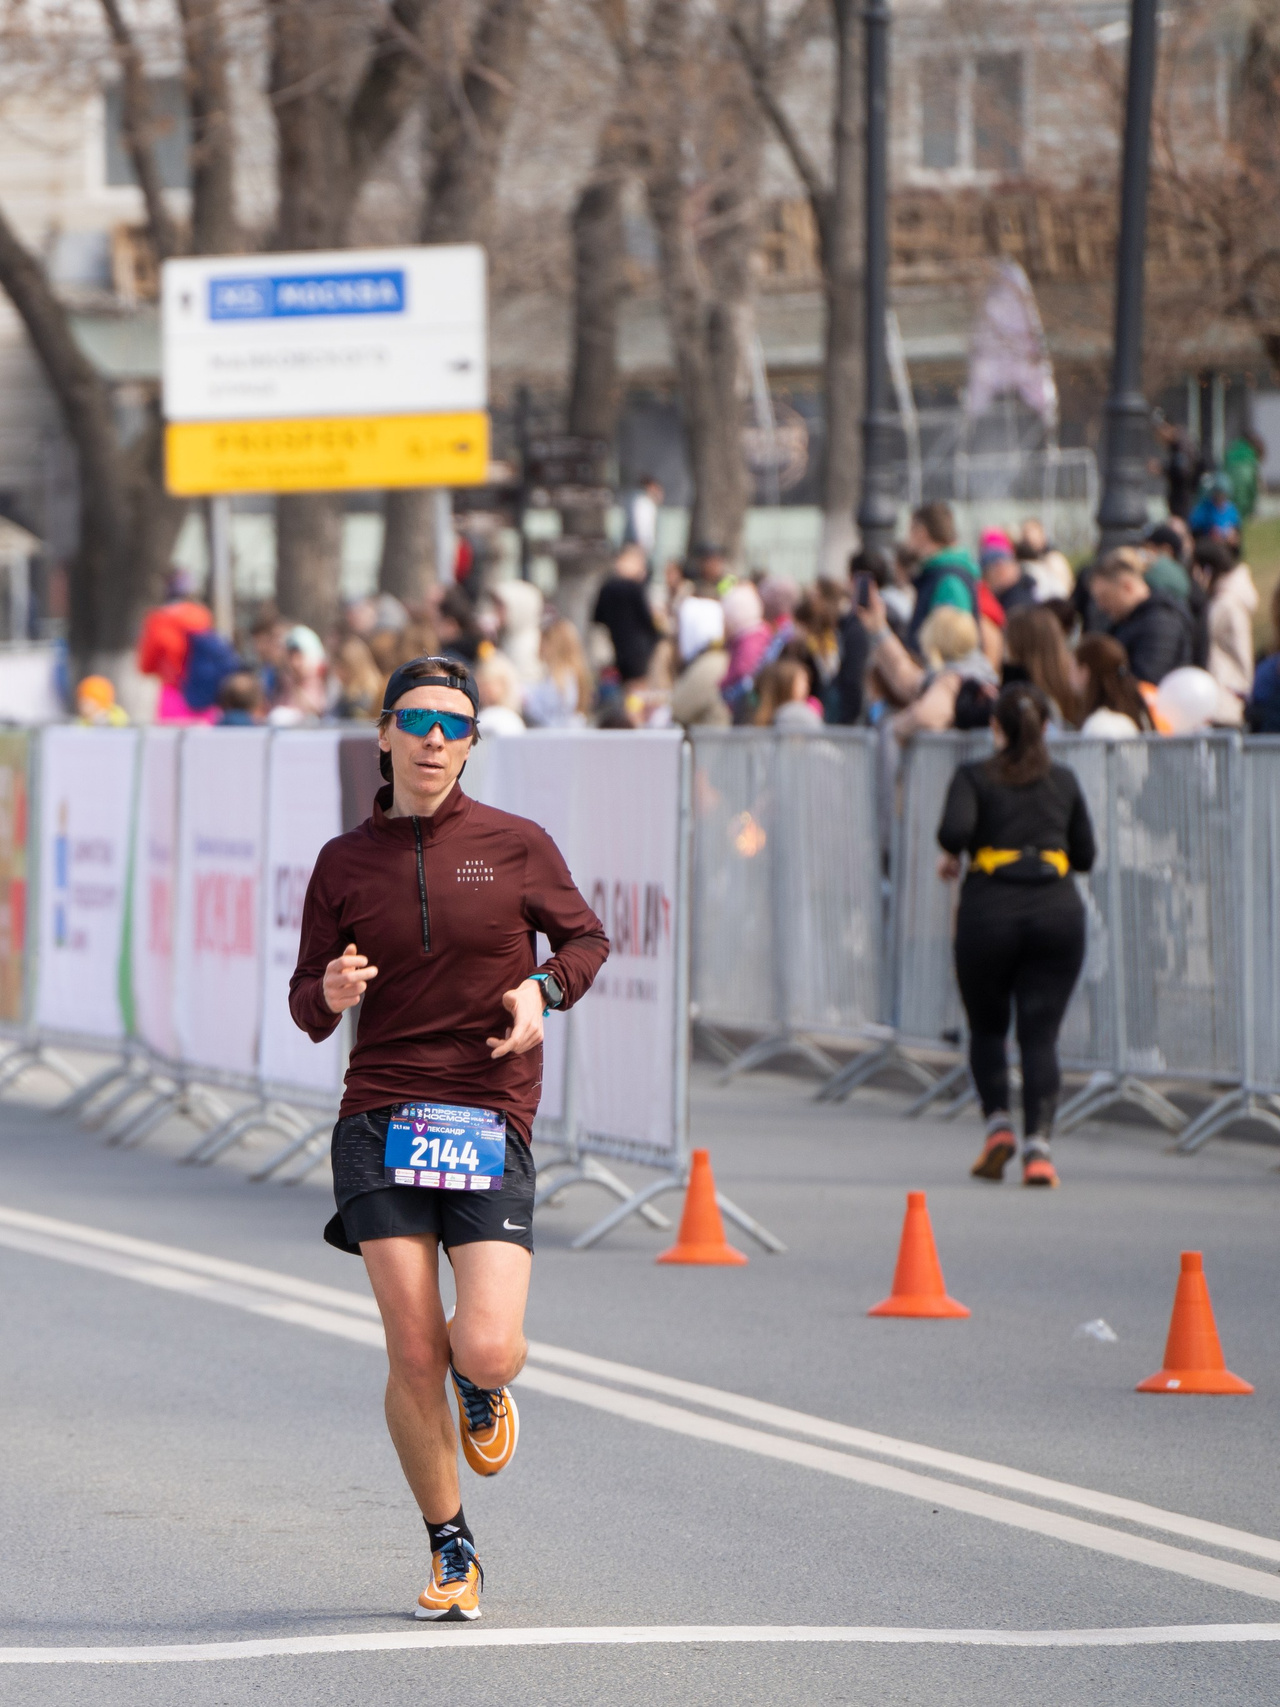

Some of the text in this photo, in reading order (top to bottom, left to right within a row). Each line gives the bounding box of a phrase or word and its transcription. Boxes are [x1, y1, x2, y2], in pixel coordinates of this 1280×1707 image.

[431, 1108, 471, 1117] ПРОСТО
[423, 1113, 470, 1123] КОСМОС
[409, 1136, 480, 1171] 2144
